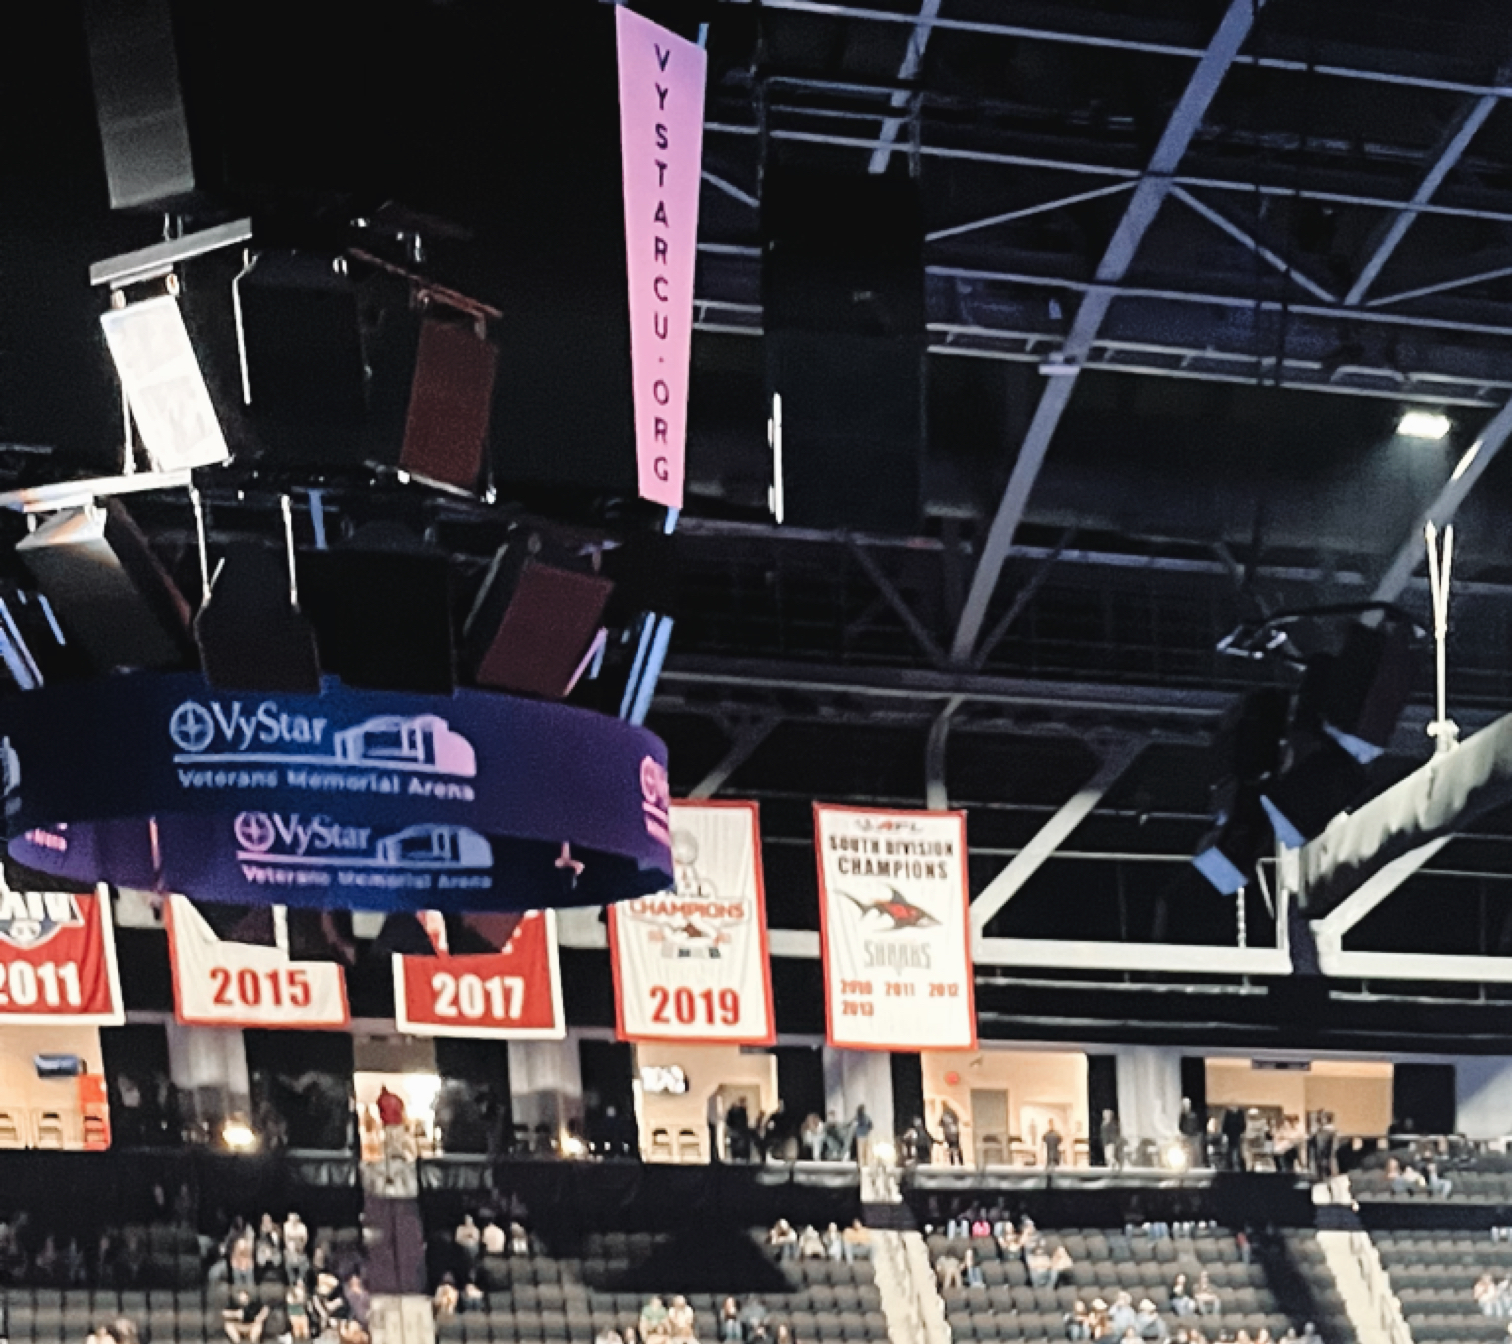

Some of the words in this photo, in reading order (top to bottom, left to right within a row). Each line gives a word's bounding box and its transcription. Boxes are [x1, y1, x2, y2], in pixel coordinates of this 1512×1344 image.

[210, 700, 327, 751] VyStar
[177, 768, 279, 788] Veterans
[286, 769, 400, 794] Memorial
[408, 777, 475, 801] Arena
[273, 812, 371, 855] VyStar
[241, 863, 331, 886] Veterans
[338, 869, 432, 889] Memorial
[838, 856, 948, 880] CHAMPIONS
[210, 966, 312, 1007] 2015
[431, 972, 525, 1020] 2017
[649, 985, 741, 1026] 2019
